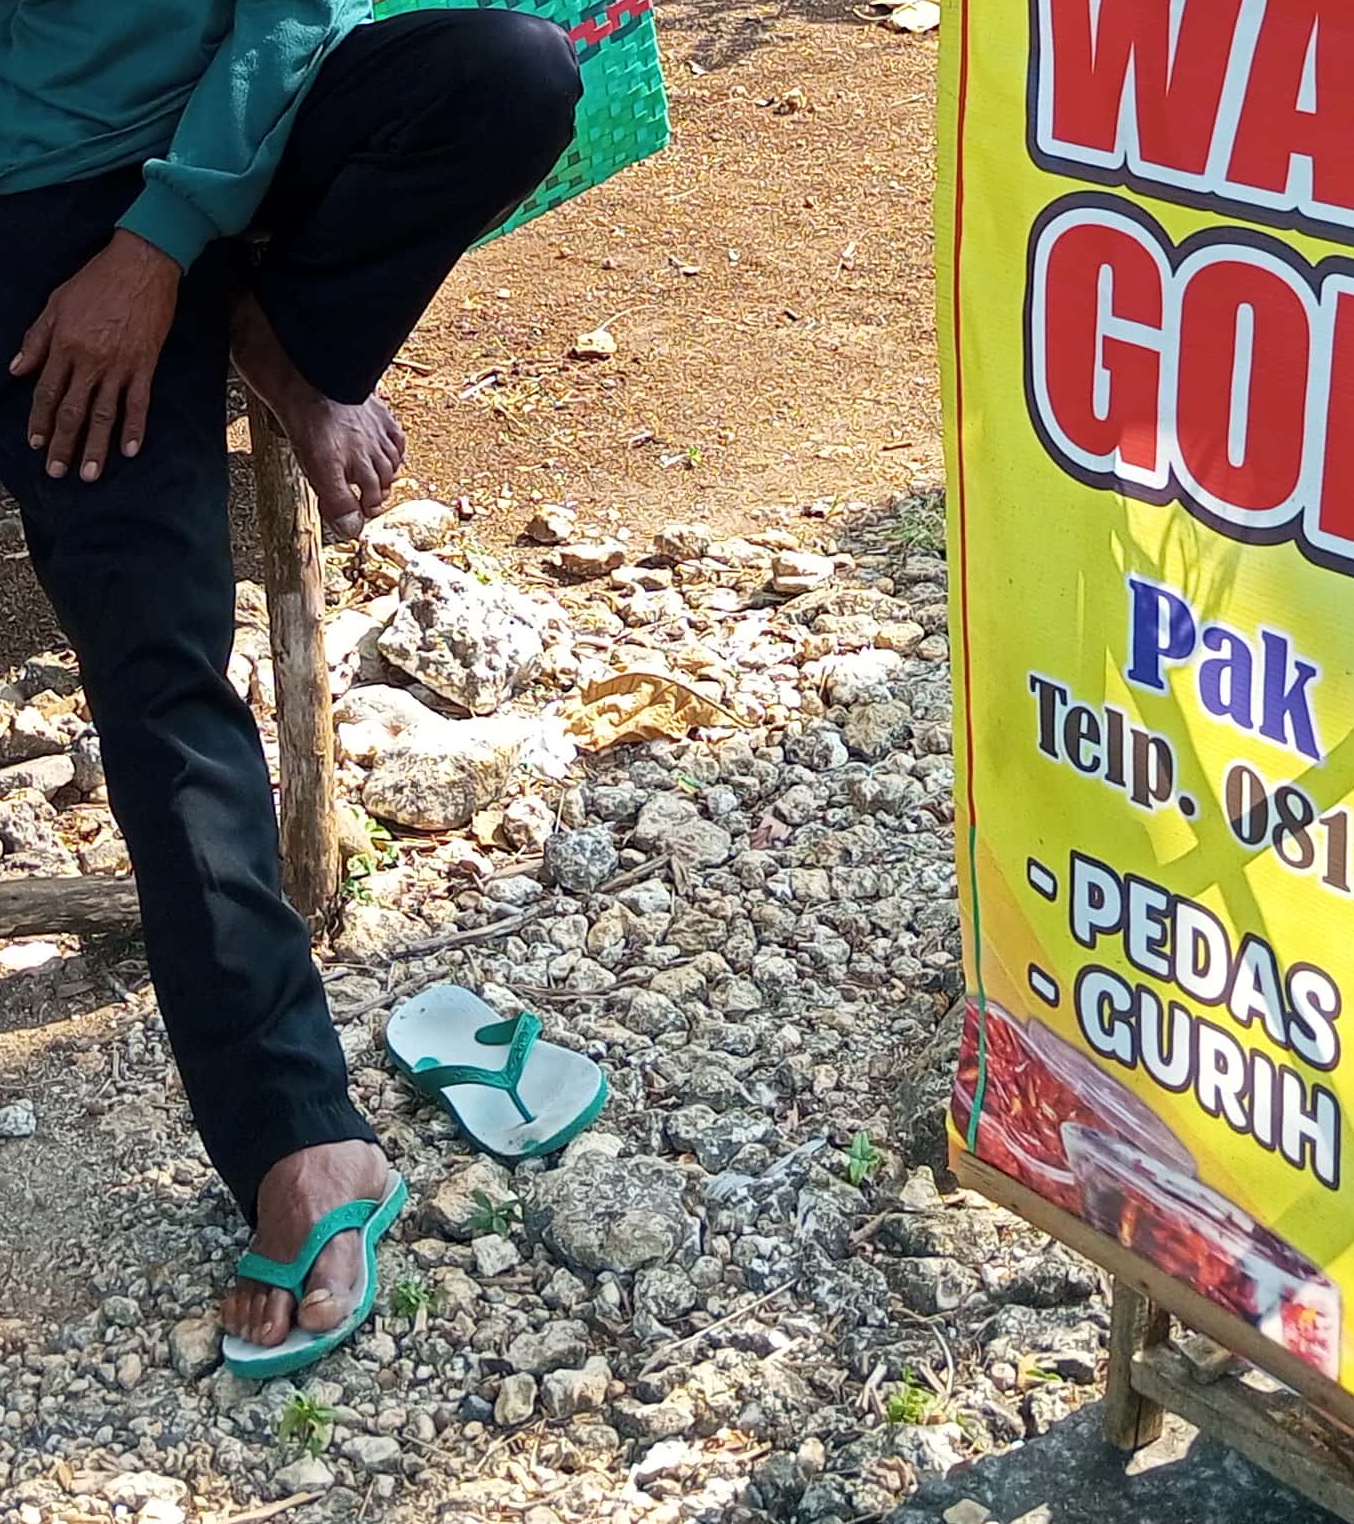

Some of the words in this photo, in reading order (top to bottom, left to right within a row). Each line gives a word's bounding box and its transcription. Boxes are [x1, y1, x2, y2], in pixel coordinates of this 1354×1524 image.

[1029, 675, 1197, 817] Telp.
[1127, 578, 1322, 761] Pak
[1071, 854, 1340, 1069] PEDAS
[1077, 964, 1341, 1189] GURIH
